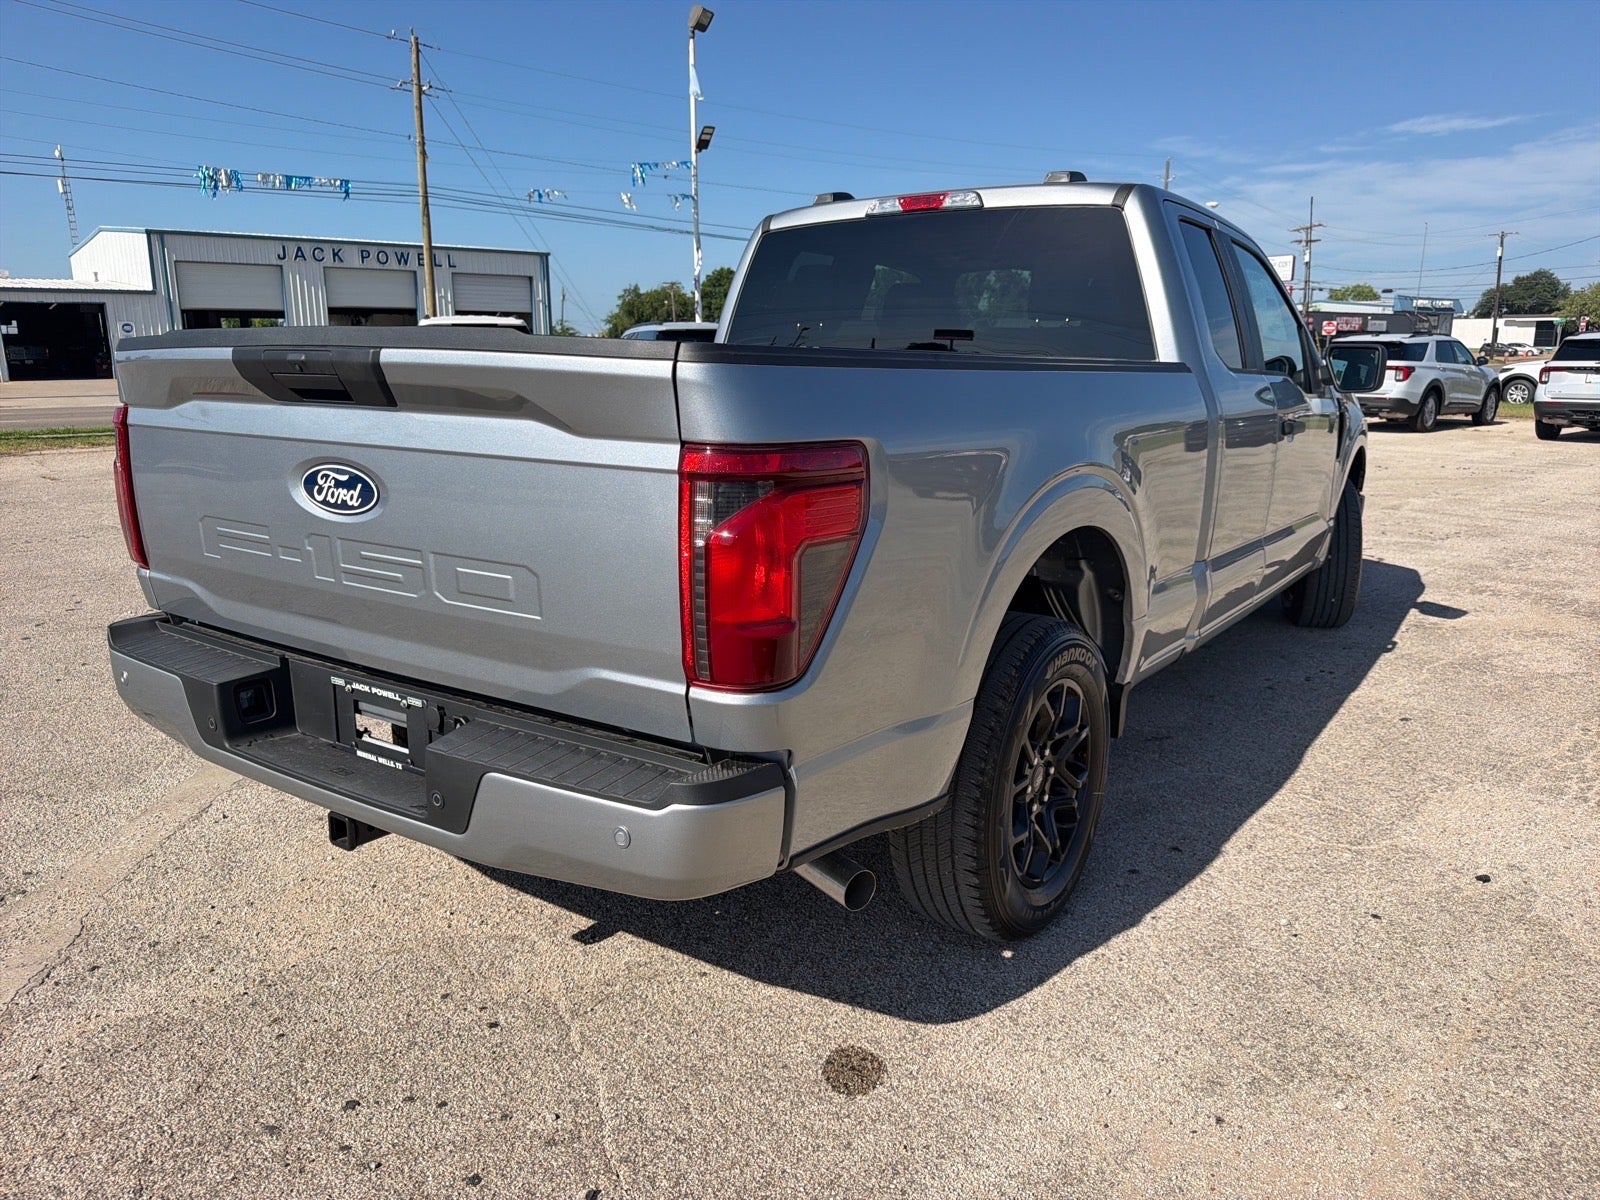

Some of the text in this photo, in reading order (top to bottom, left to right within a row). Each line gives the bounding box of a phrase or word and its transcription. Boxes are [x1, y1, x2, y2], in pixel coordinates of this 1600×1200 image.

[277, 245, 457, 269] JACK POWELL
[313, 470, 362, 507] Ford
[199, 515, 543, 621] F-150
[351, 682, 371, 693] JACK
[371, 687, 402, 702] POWELL
